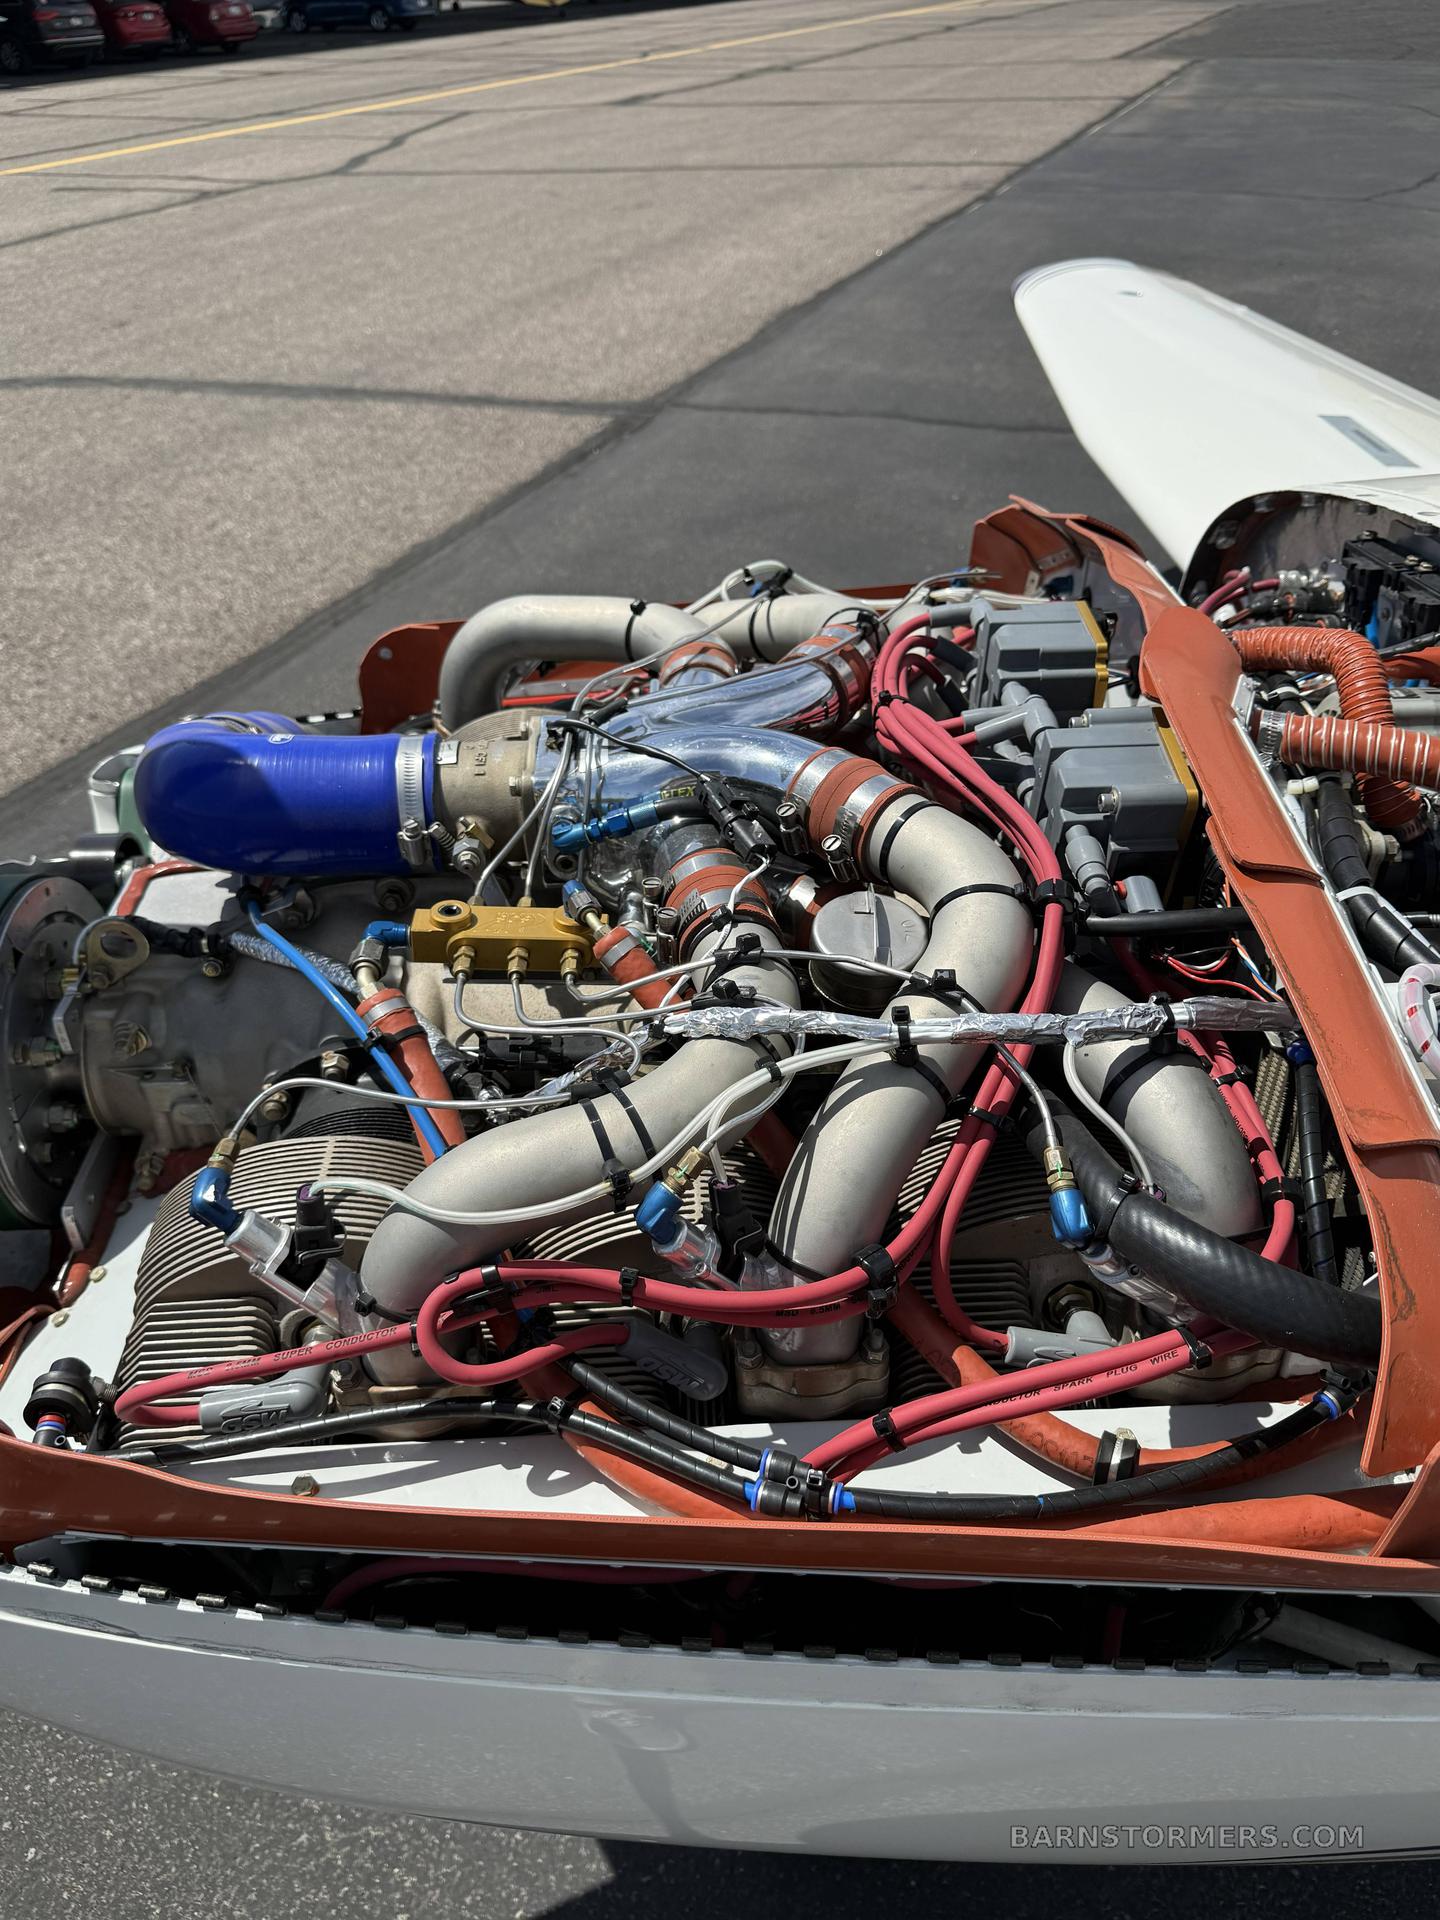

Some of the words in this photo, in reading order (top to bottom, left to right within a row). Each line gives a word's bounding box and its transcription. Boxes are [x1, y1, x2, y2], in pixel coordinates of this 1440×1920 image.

[273, 1346, 314, 1362] SUPER
[325, 1326, 398, 1350] CONDUCTOR
[1053, 1376, 1093, 1392] SPARK
[1105, 1364, 1138, 1378] PLUG
[1149, 1349, 1180, 1366] WIRE
